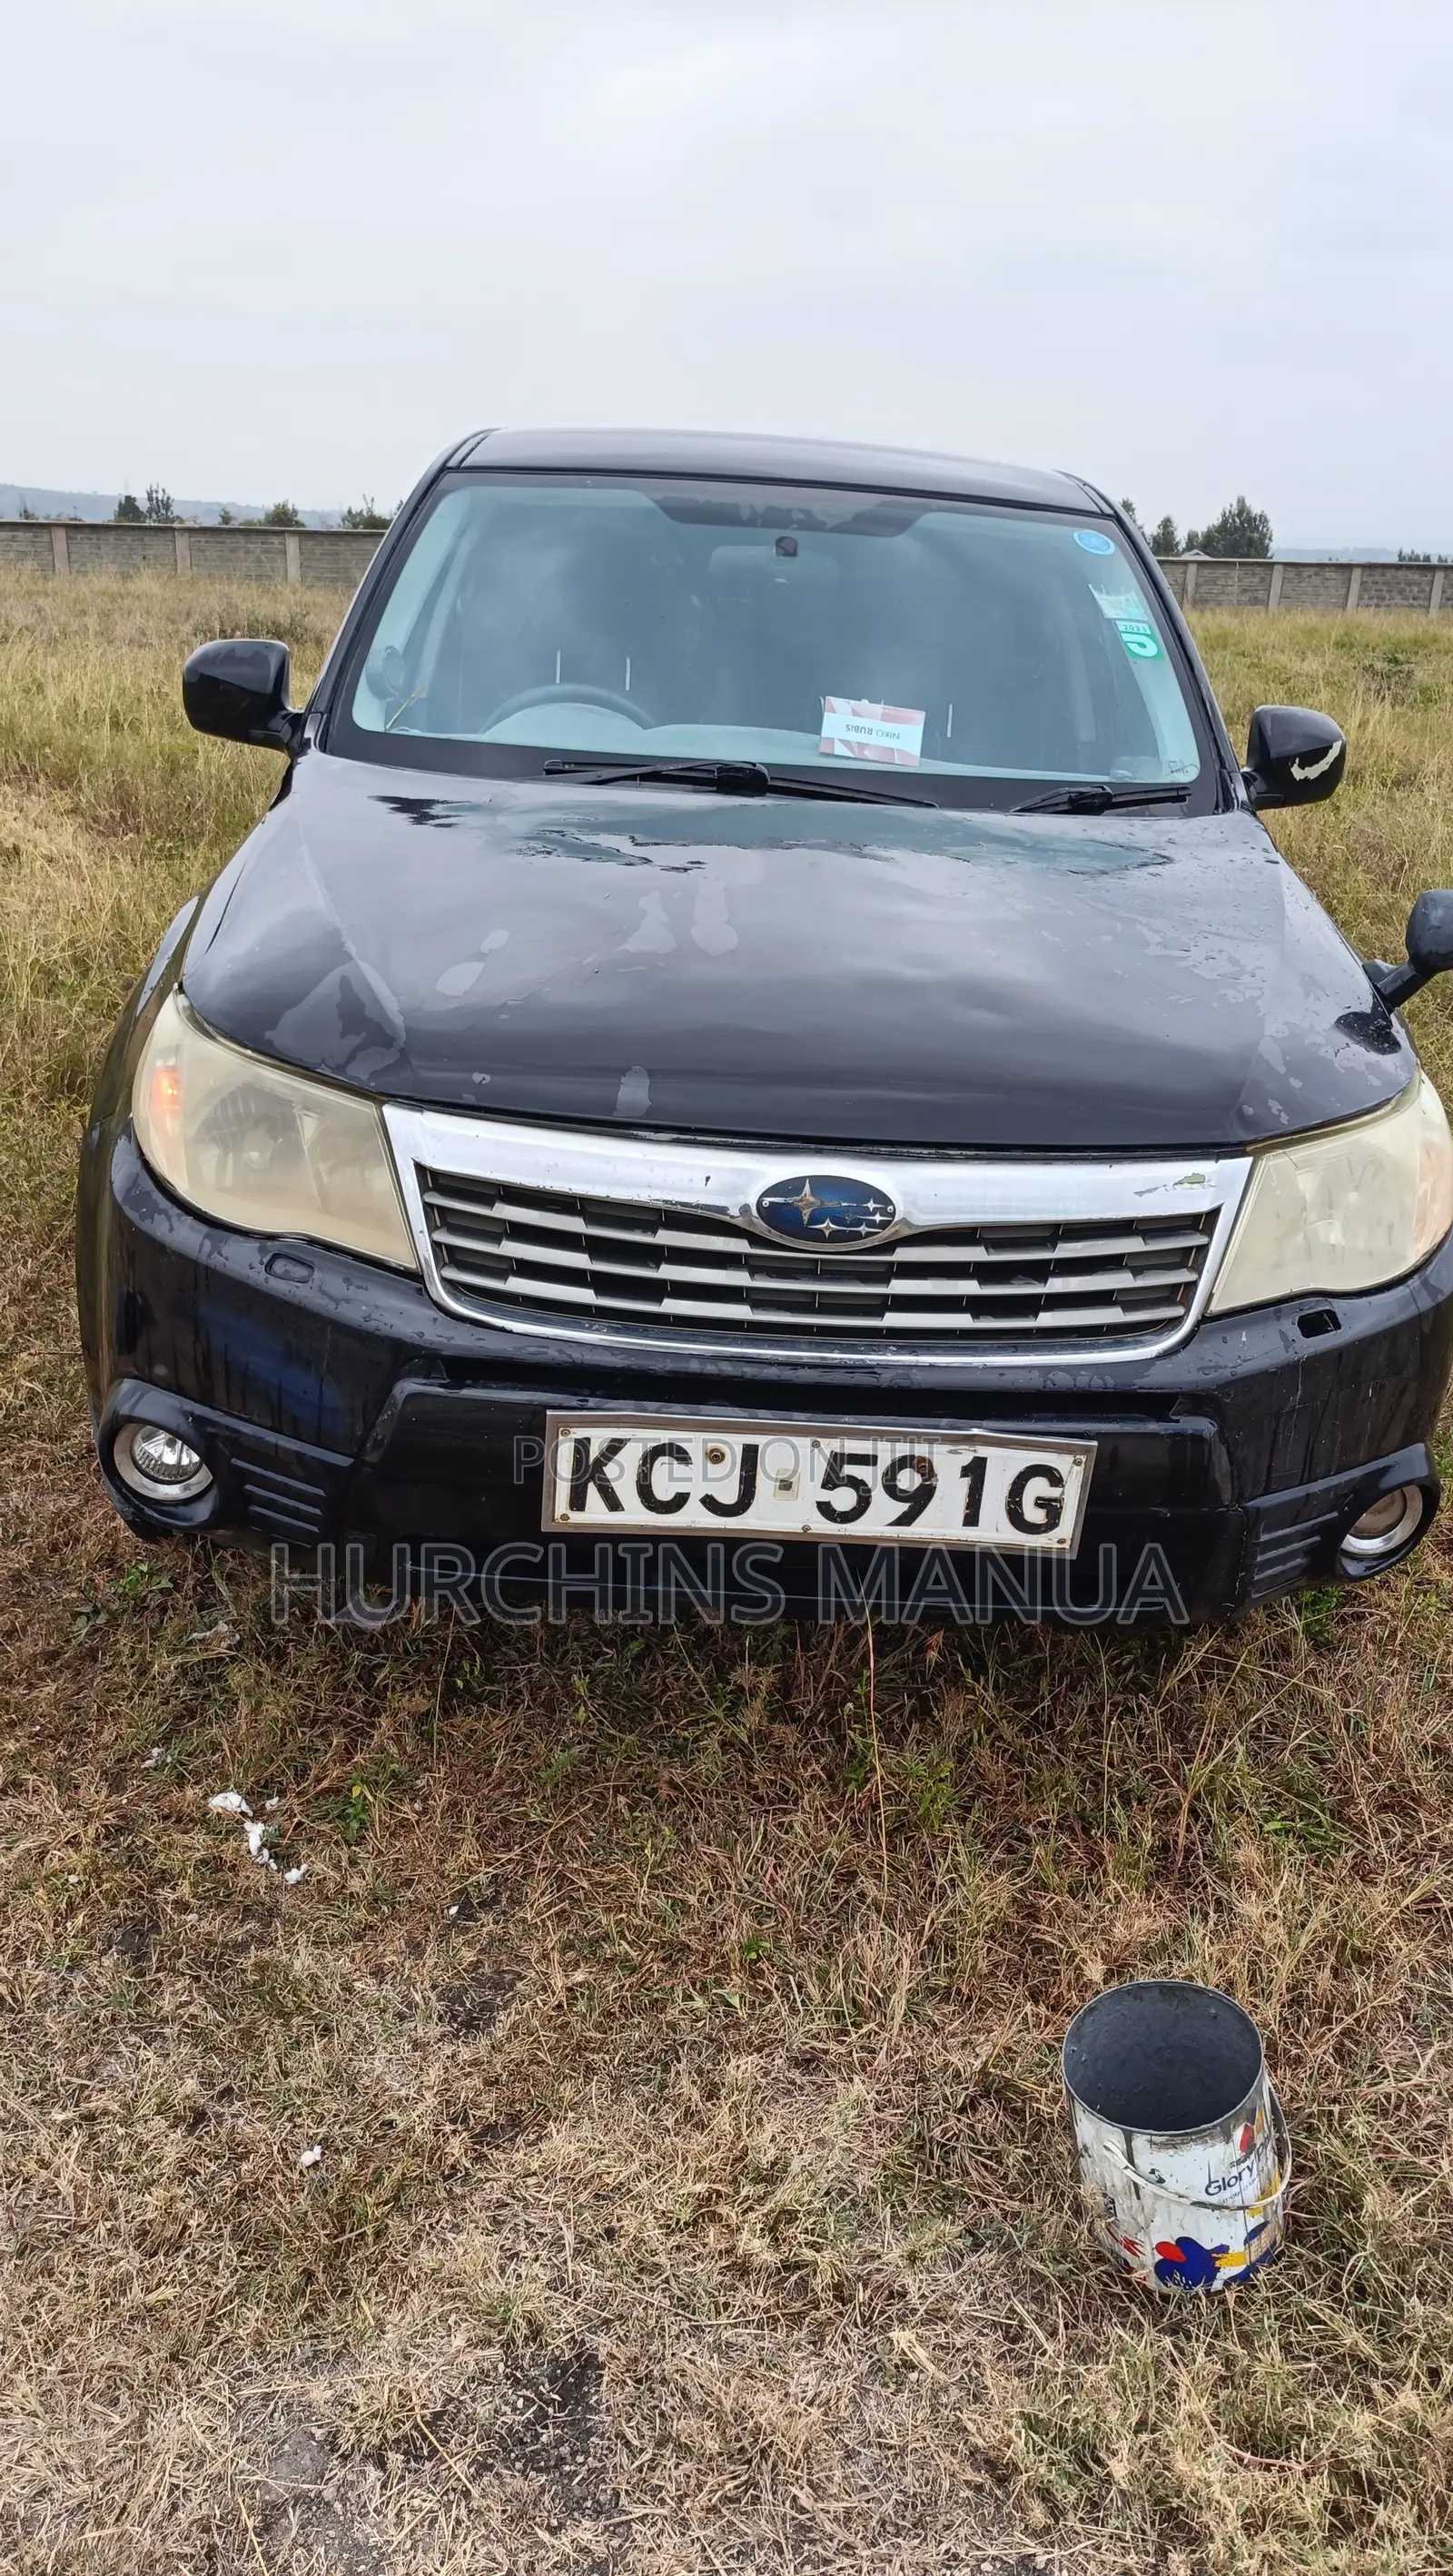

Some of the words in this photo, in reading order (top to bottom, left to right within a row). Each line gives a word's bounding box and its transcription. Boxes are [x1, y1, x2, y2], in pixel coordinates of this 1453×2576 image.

[875, 728, 901, 740] NIKO
[569, 1436, 760, 1518] KCJ
[815, 1452, 1066, 1535] 591G
[1205, 2159, 1254, 2196] Glory
